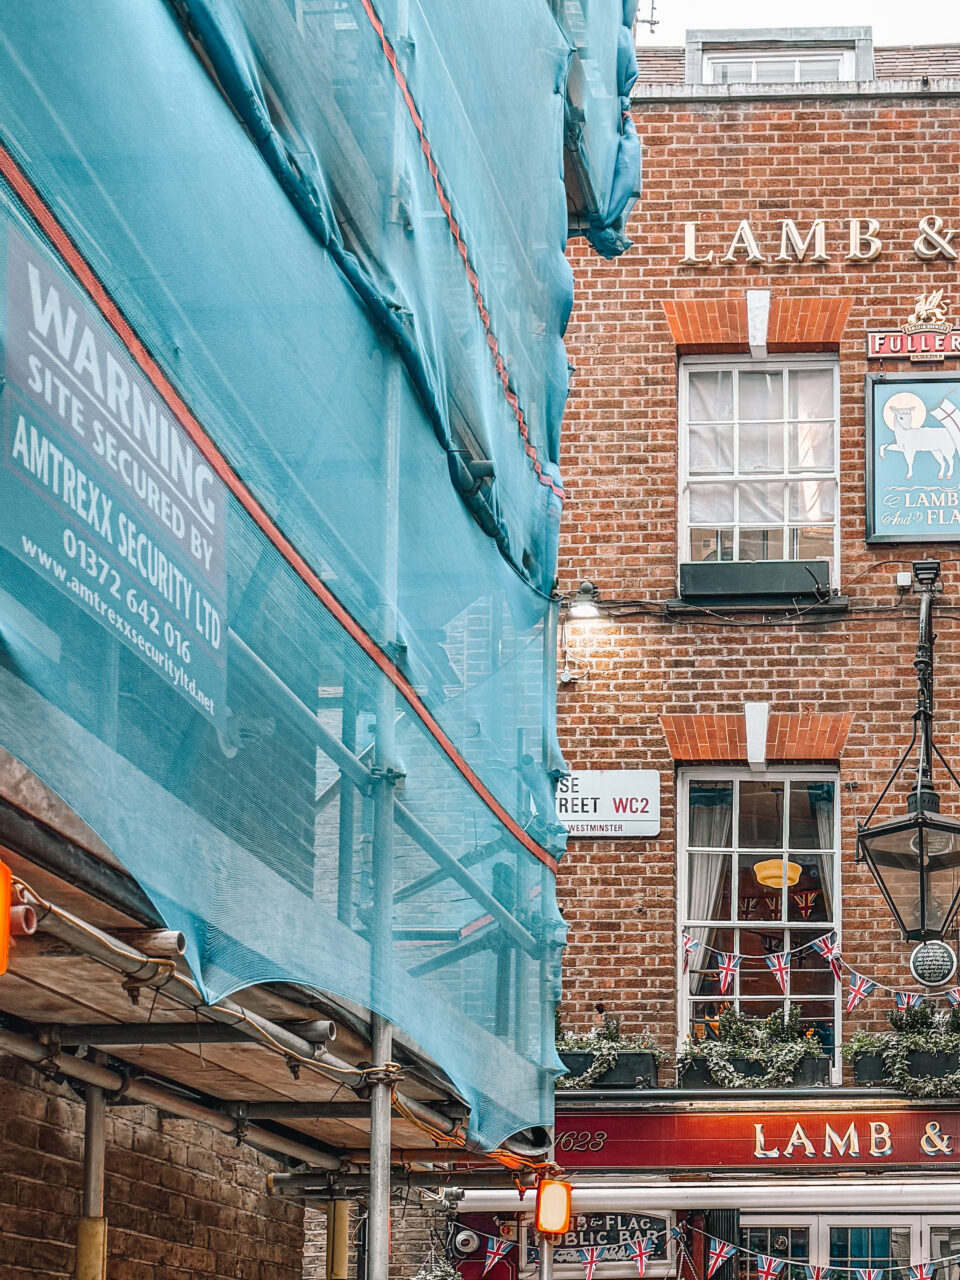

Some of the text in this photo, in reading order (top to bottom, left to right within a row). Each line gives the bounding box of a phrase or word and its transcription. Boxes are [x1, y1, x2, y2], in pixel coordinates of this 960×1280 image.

[679, 217, 882, 266] LAMB
[913, 215, 960, 260] &
[27, 261, 216, 525] WARNING
[28, 354, 213, 571] SITE SECURED BY
[905, 493, 958, 508] LAMB
[12, 414, 221, 650] AMTREXX SECURITY LTD
[881, 511, 912, 525] And
[63, 528, 190, 664] 01372 642 016
[22, 535, 215, 716] www.amtrexxsecurityltd.net
[560, 778, 580, 793] SE
[613, 797, 649, 813] WC2
[569, 824, 623, 832] WESTMINSTER
[554, 1131, 607, 1151] 1623
[753, 1120, 894, 1159] LAMB
[919, 1121, 951, 1154] &
[619, 1231, 659, 1246] BAR
